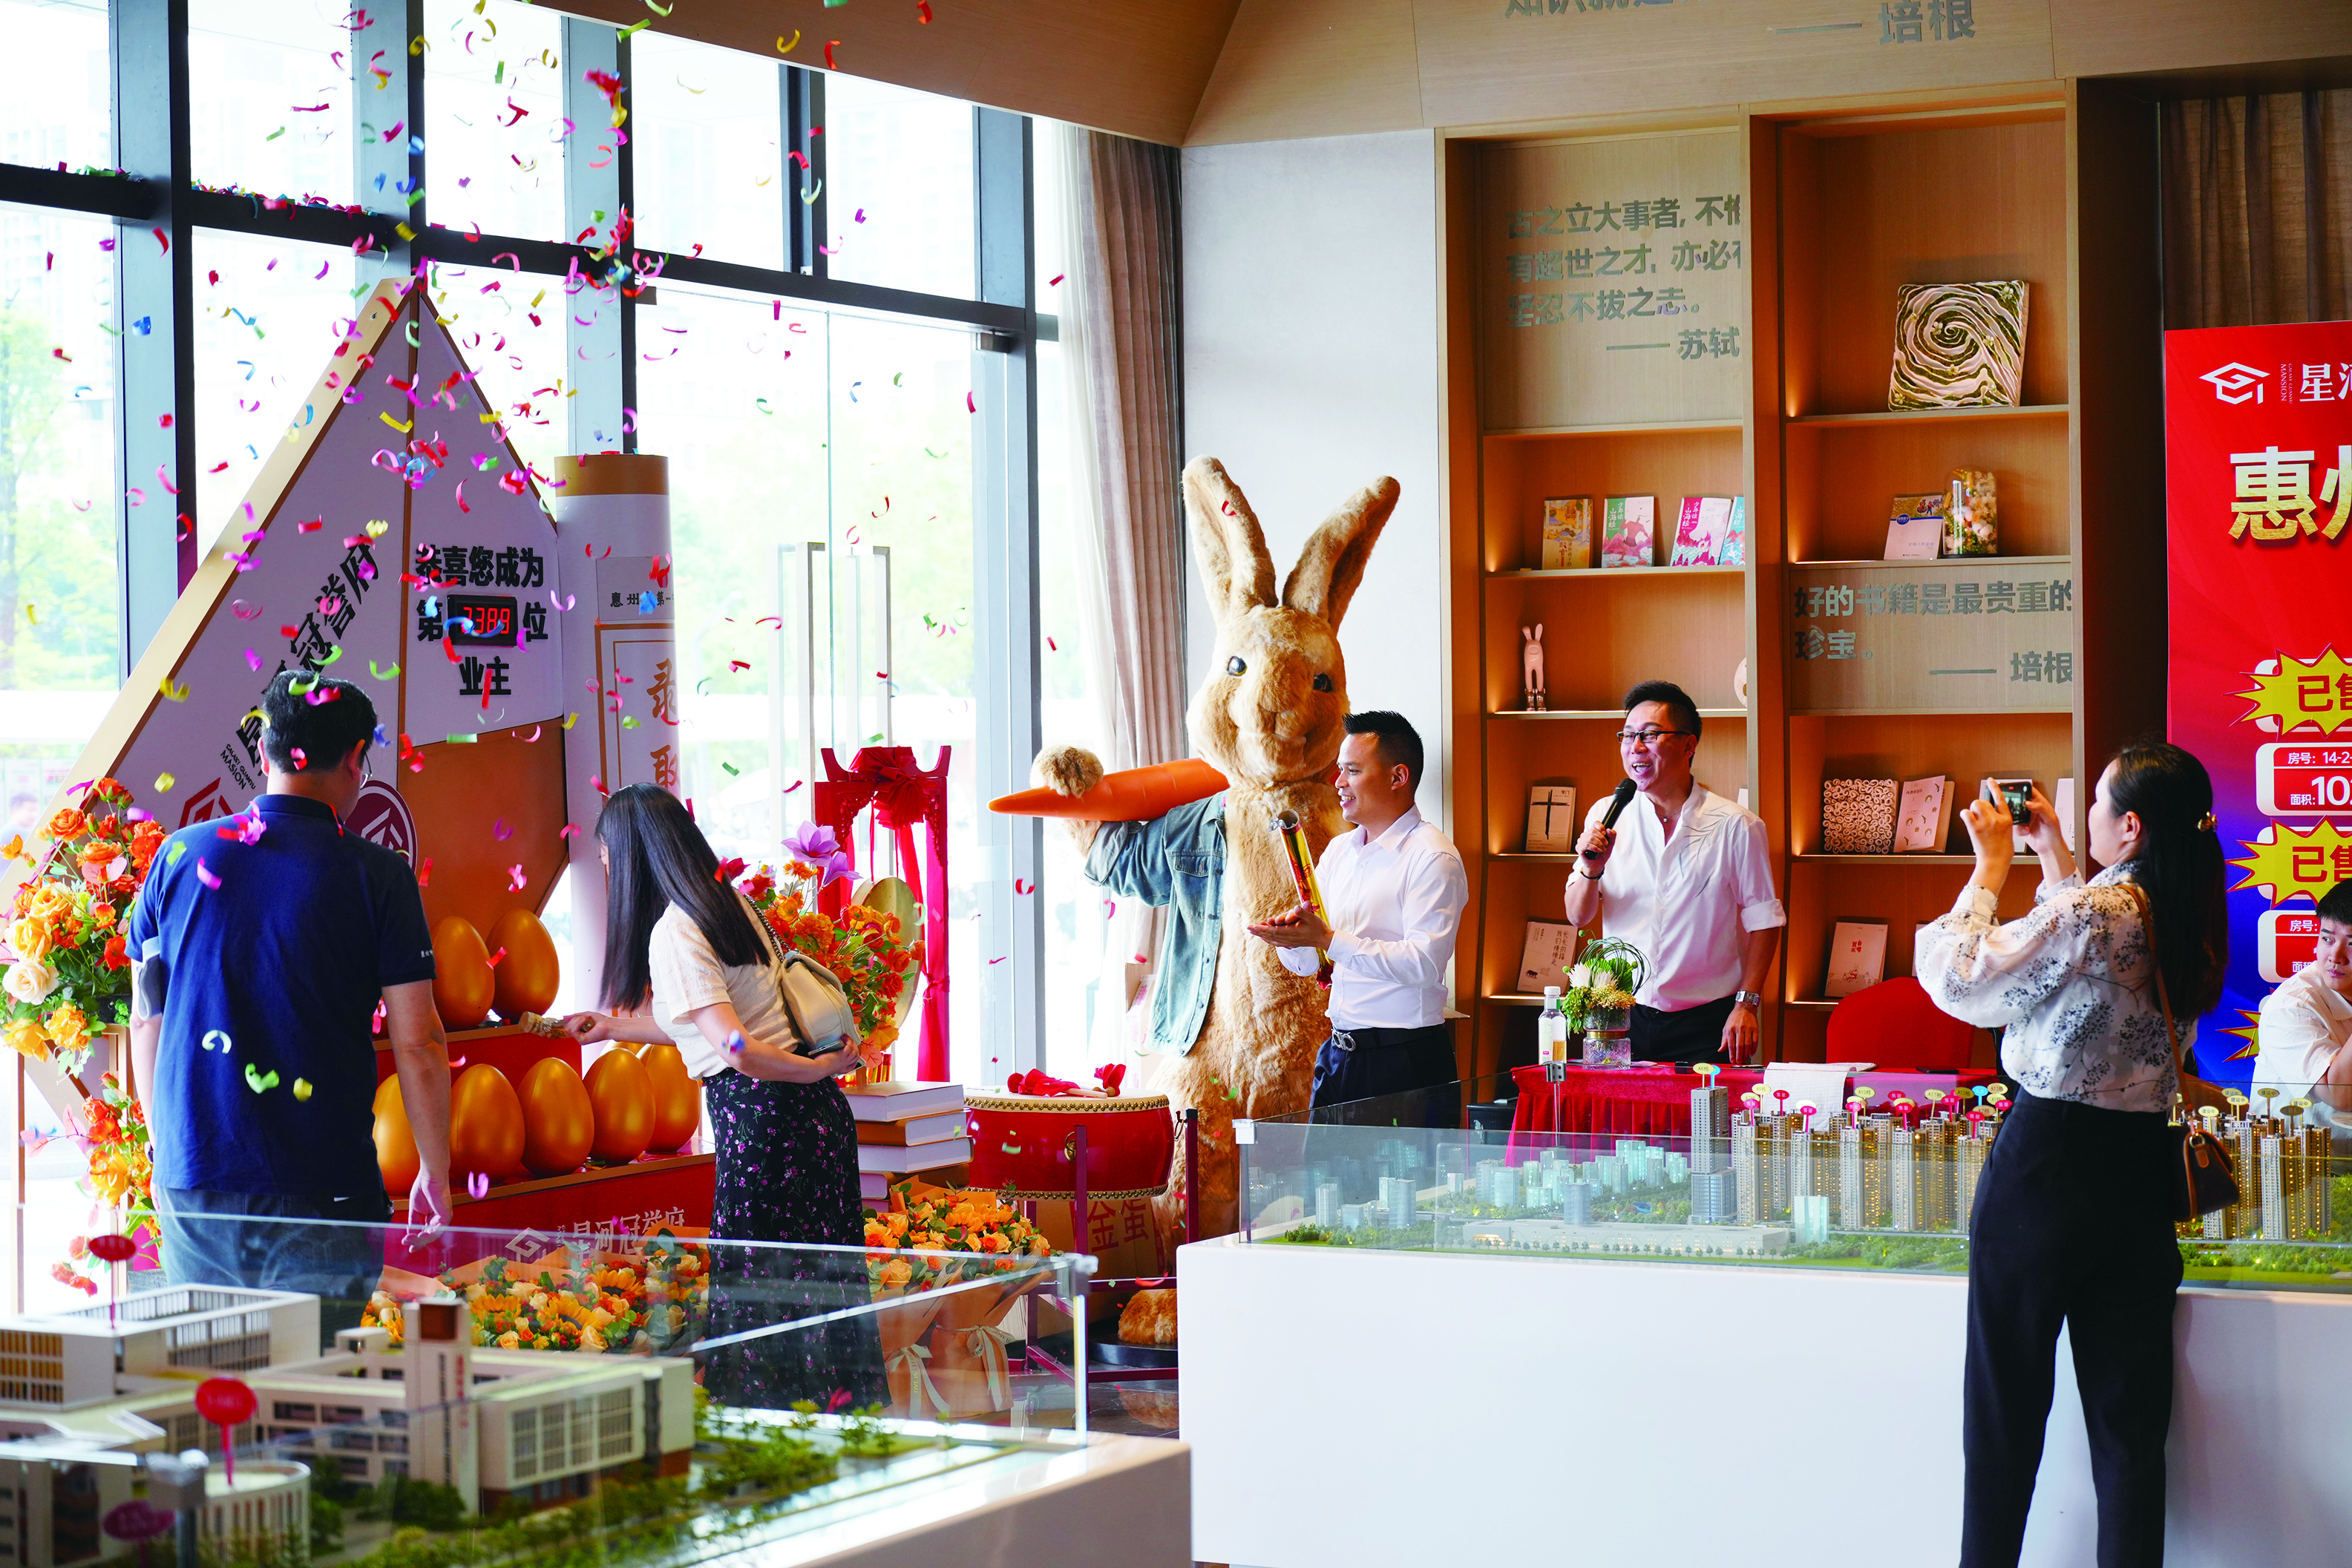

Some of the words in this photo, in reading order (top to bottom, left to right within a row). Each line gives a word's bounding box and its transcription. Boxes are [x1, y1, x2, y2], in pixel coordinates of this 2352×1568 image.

[416, 544, 544, 588] 恭喜您成为
[459, 656, 511, 695] 业主
[220, 750, 247, 790] MASION
[2311, 775, 2352, 806] 10
